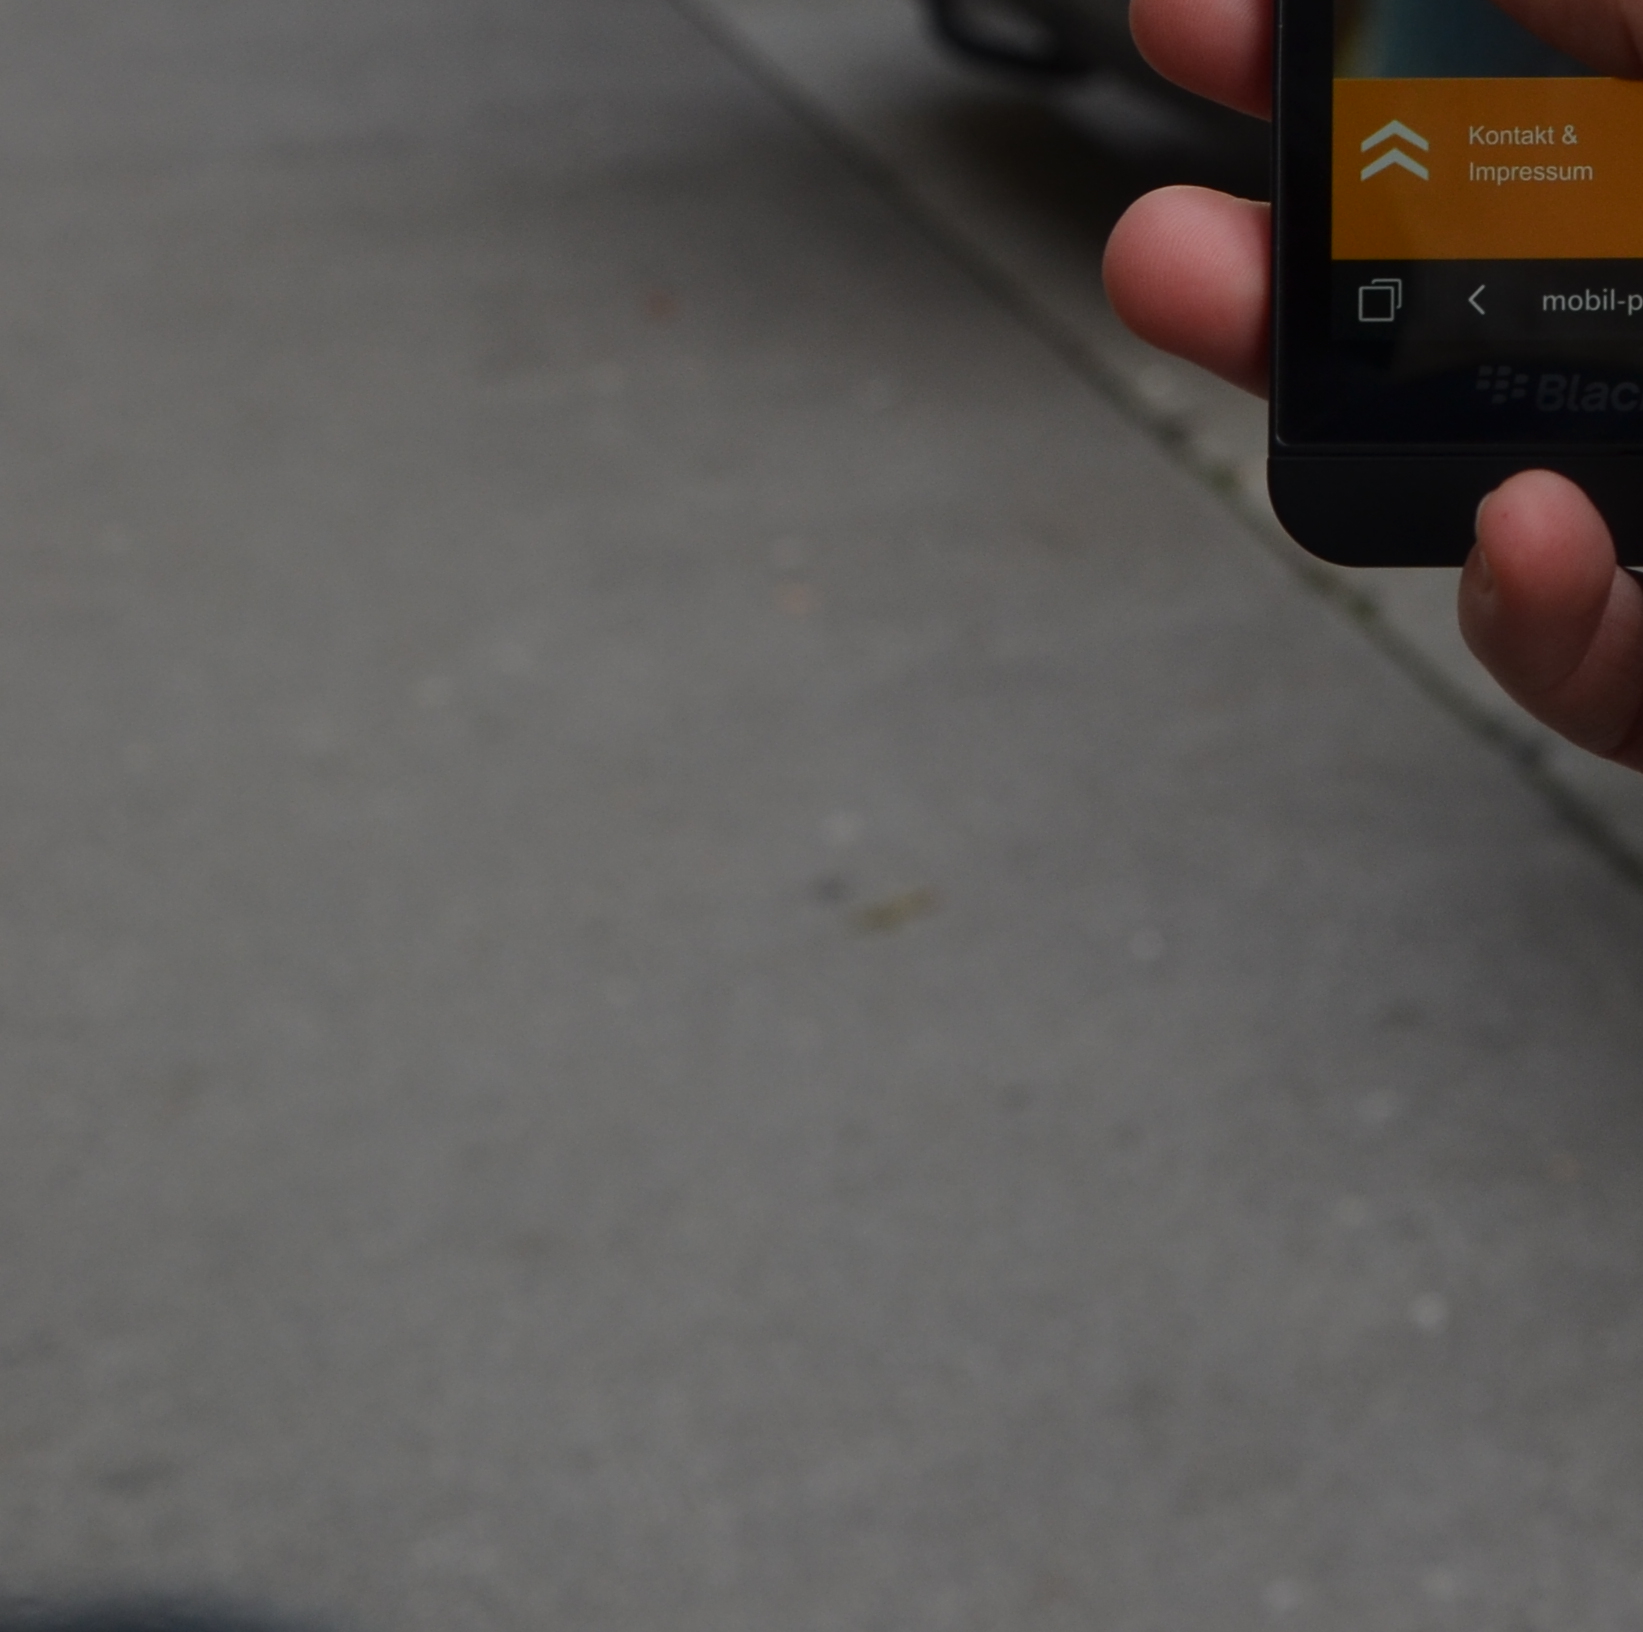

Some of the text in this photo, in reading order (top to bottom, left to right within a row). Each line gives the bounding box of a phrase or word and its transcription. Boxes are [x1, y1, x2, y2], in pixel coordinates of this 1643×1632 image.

[1468, 125, 1578, 146] Kontakt &
[1468, 161, 1594, 186] Impressum
